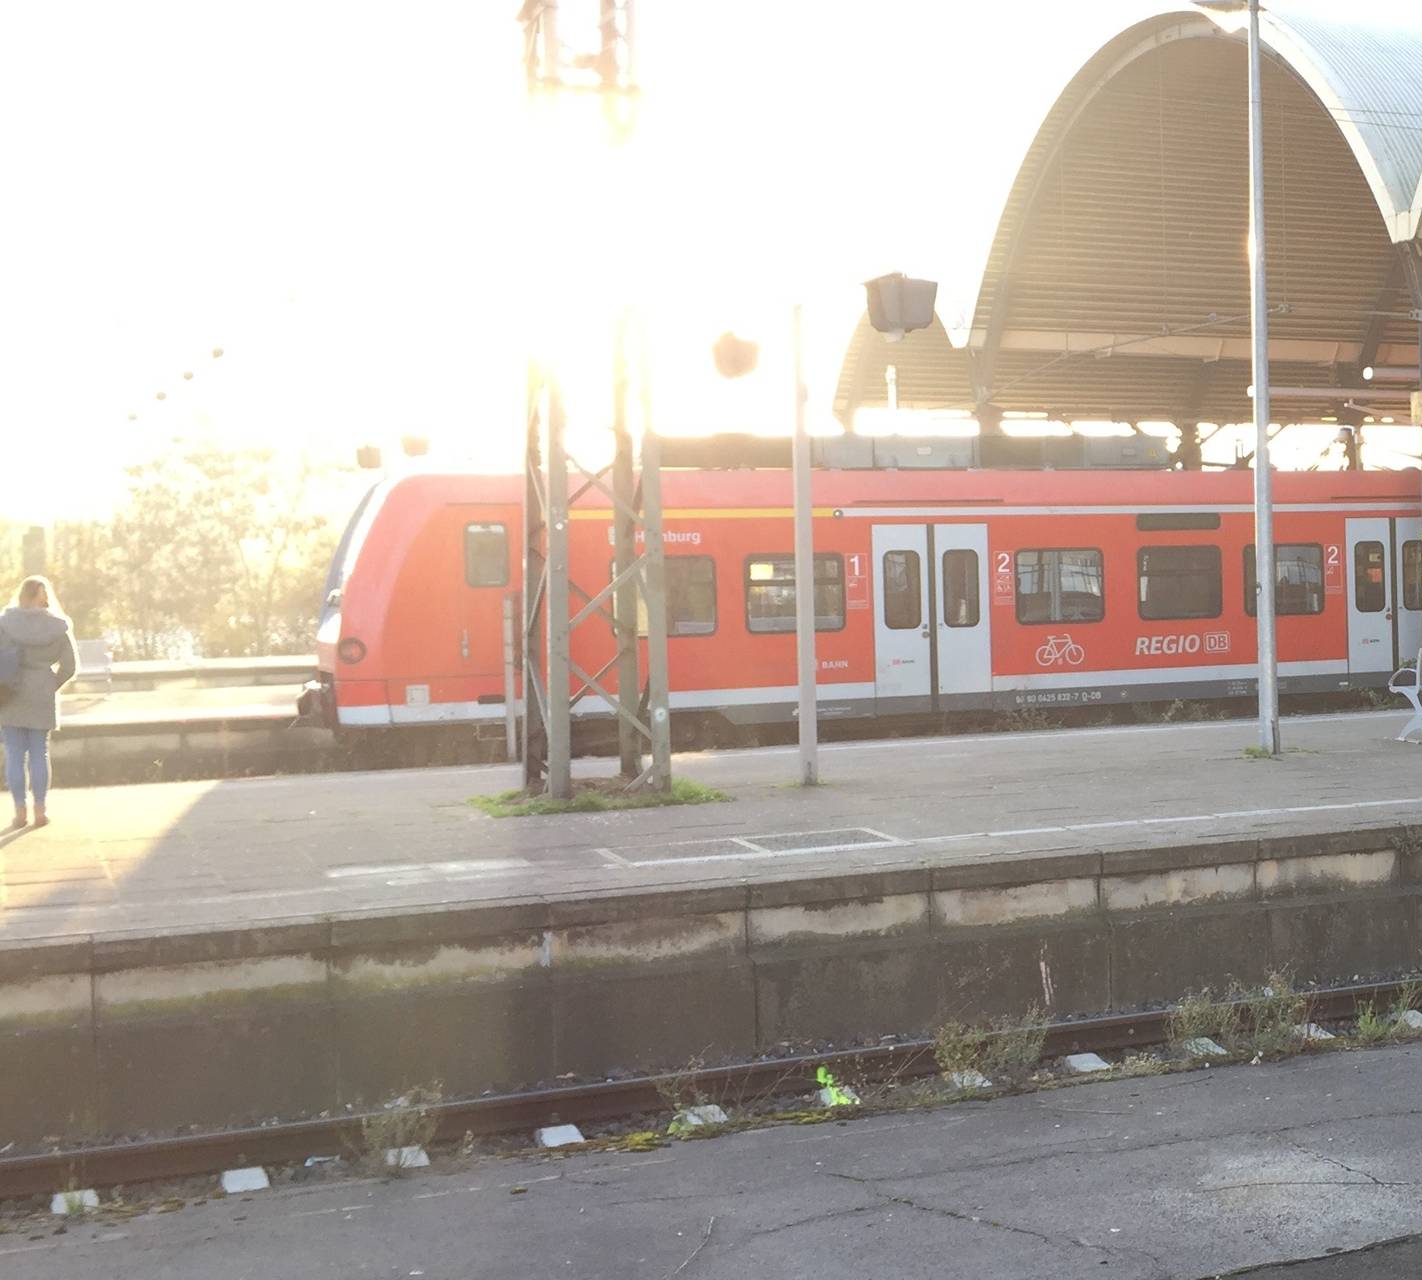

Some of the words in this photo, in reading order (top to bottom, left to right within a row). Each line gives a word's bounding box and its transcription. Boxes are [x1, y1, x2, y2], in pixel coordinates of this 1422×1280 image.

[634, 530, 701, 545] Hburg
[997, 552, 1010, 573] 2
[1327, 545, 1339, 564] 2
[850, 555, 860, 576] 1
[1135, 634, 1199, 656] REGIO
[1206, 634, 1228, 650] DB
